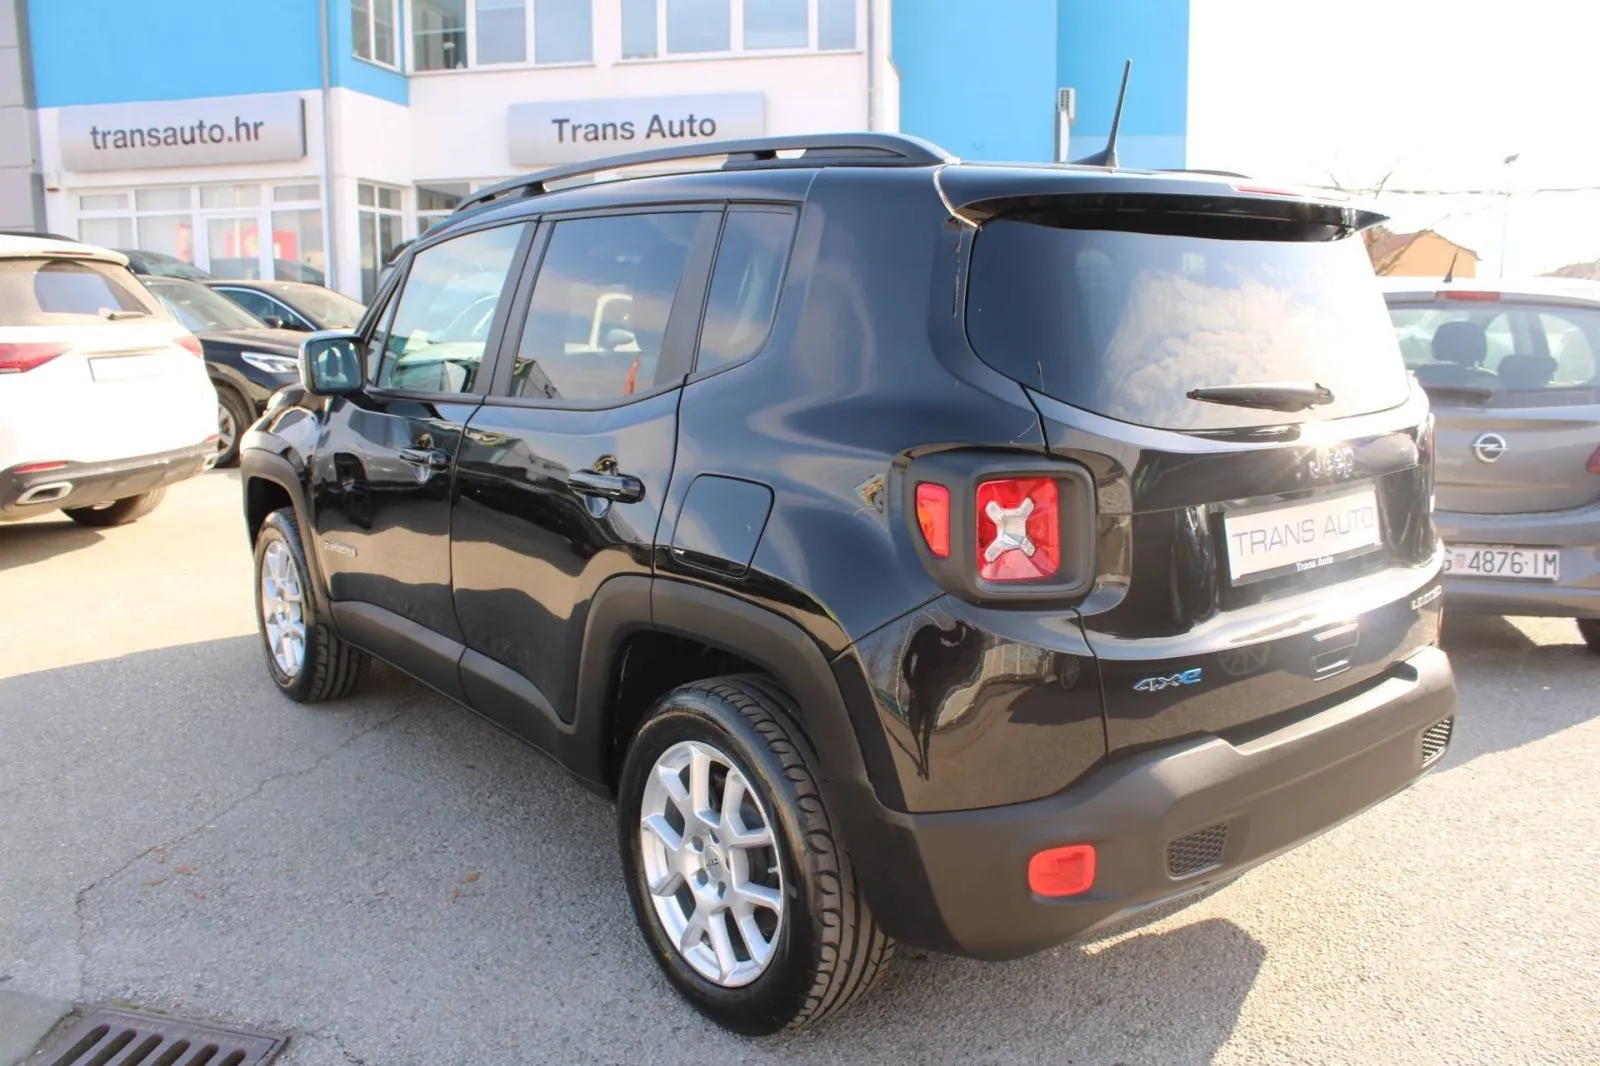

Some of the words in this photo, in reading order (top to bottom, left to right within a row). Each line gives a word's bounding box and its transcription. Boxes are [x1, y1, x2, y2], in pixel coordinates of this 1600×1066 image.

[90, 116, 264, 150] transauto.hr
[551, 118, 635, 143] Trans
[645, 114, 717, 139] Auto
[1232, 519, 1316, 557] TRANS
[1323, 506, 1375, 538] AUTO
